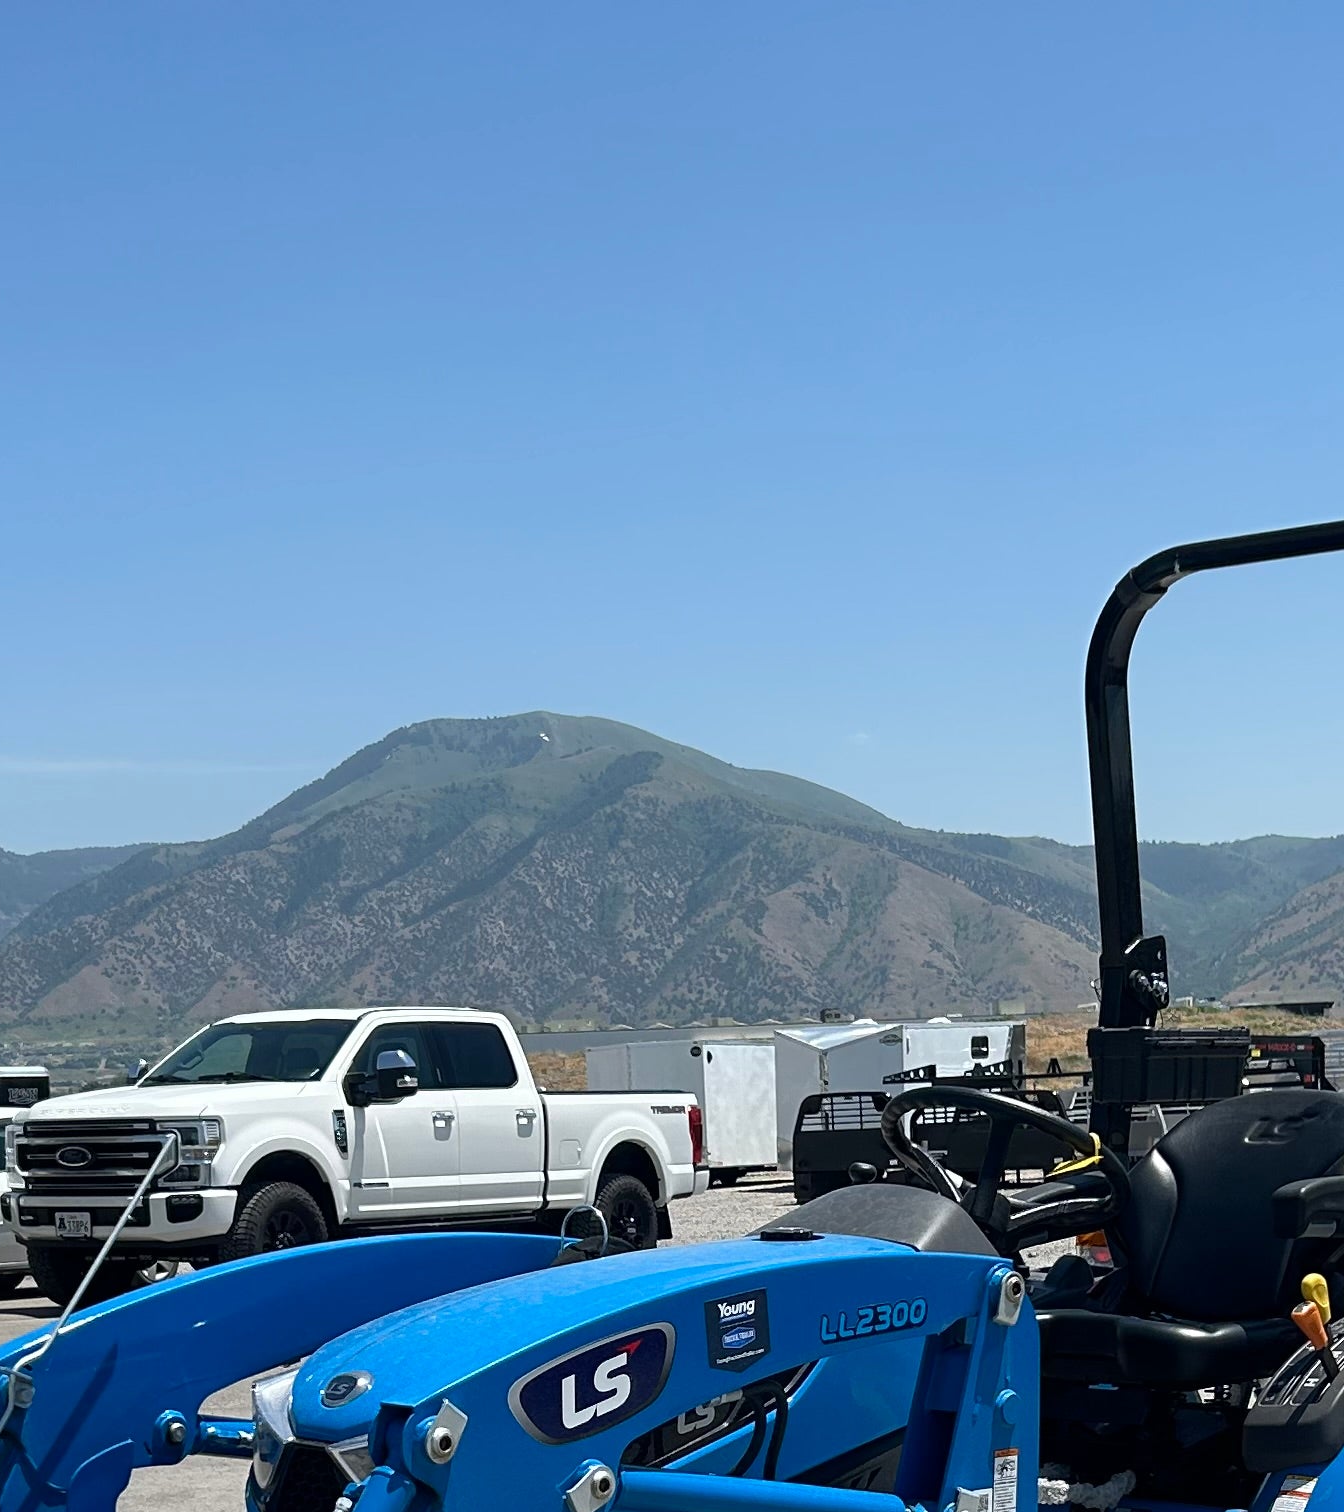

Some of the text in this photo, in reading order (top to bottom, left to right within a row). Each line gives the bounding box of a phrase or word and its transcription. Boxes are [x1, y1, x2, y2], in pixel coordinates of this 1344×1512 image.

[717, 1299, 756, 1318] Young
[820, 1298, 927, 1342] LL2300
[562, 1352, 632, 1430] LS
